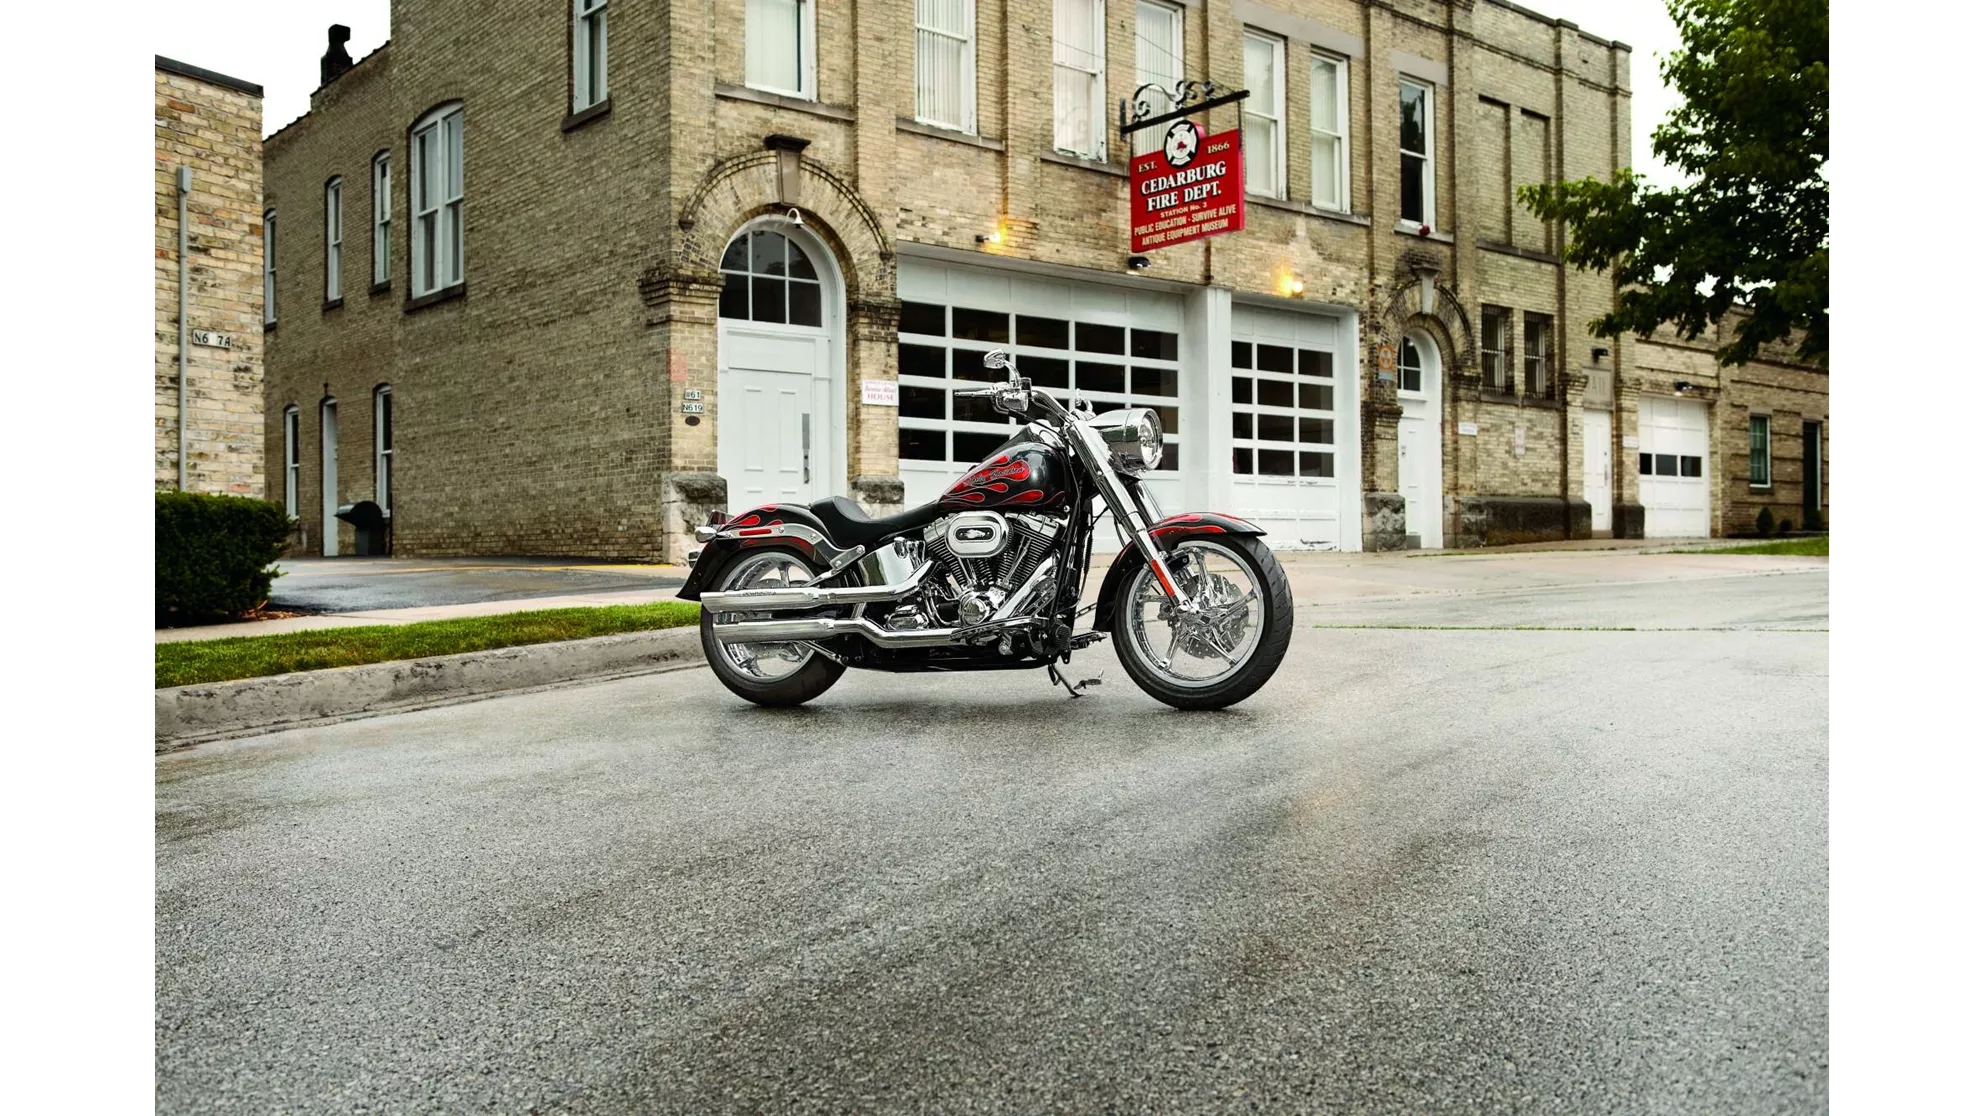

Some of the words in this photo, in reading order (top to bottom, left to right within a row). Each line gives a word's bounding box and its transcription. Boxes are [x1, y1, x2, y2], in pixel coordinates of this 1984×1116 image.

[1207, 141, 1230, 154] 1866
[1138, 161, 1158, 173] EST.
[1141, 160, 1227, 195] CEDARBURG
[1147, 191, 1179, 212] FIRE
[1184, 180, 1222, 203] DEPT.
[1134, 223, 1154, 236] PUBLIC
[1155, 216, 1187, 231] EDUCATION
[1191, 208, 1217, 223] SURVIVE
[1218, 204, 1236, 217] ALIVE
[1160, 206, 1188, 218] STATION
[1141, 233, 1166, 246] ANTIQUE
[1166, 225, 1200, 240] EQUIPMENT
[1201, 218, 1229, 233] MUSEUM
[867, 393, 894, 401] HOUSE
